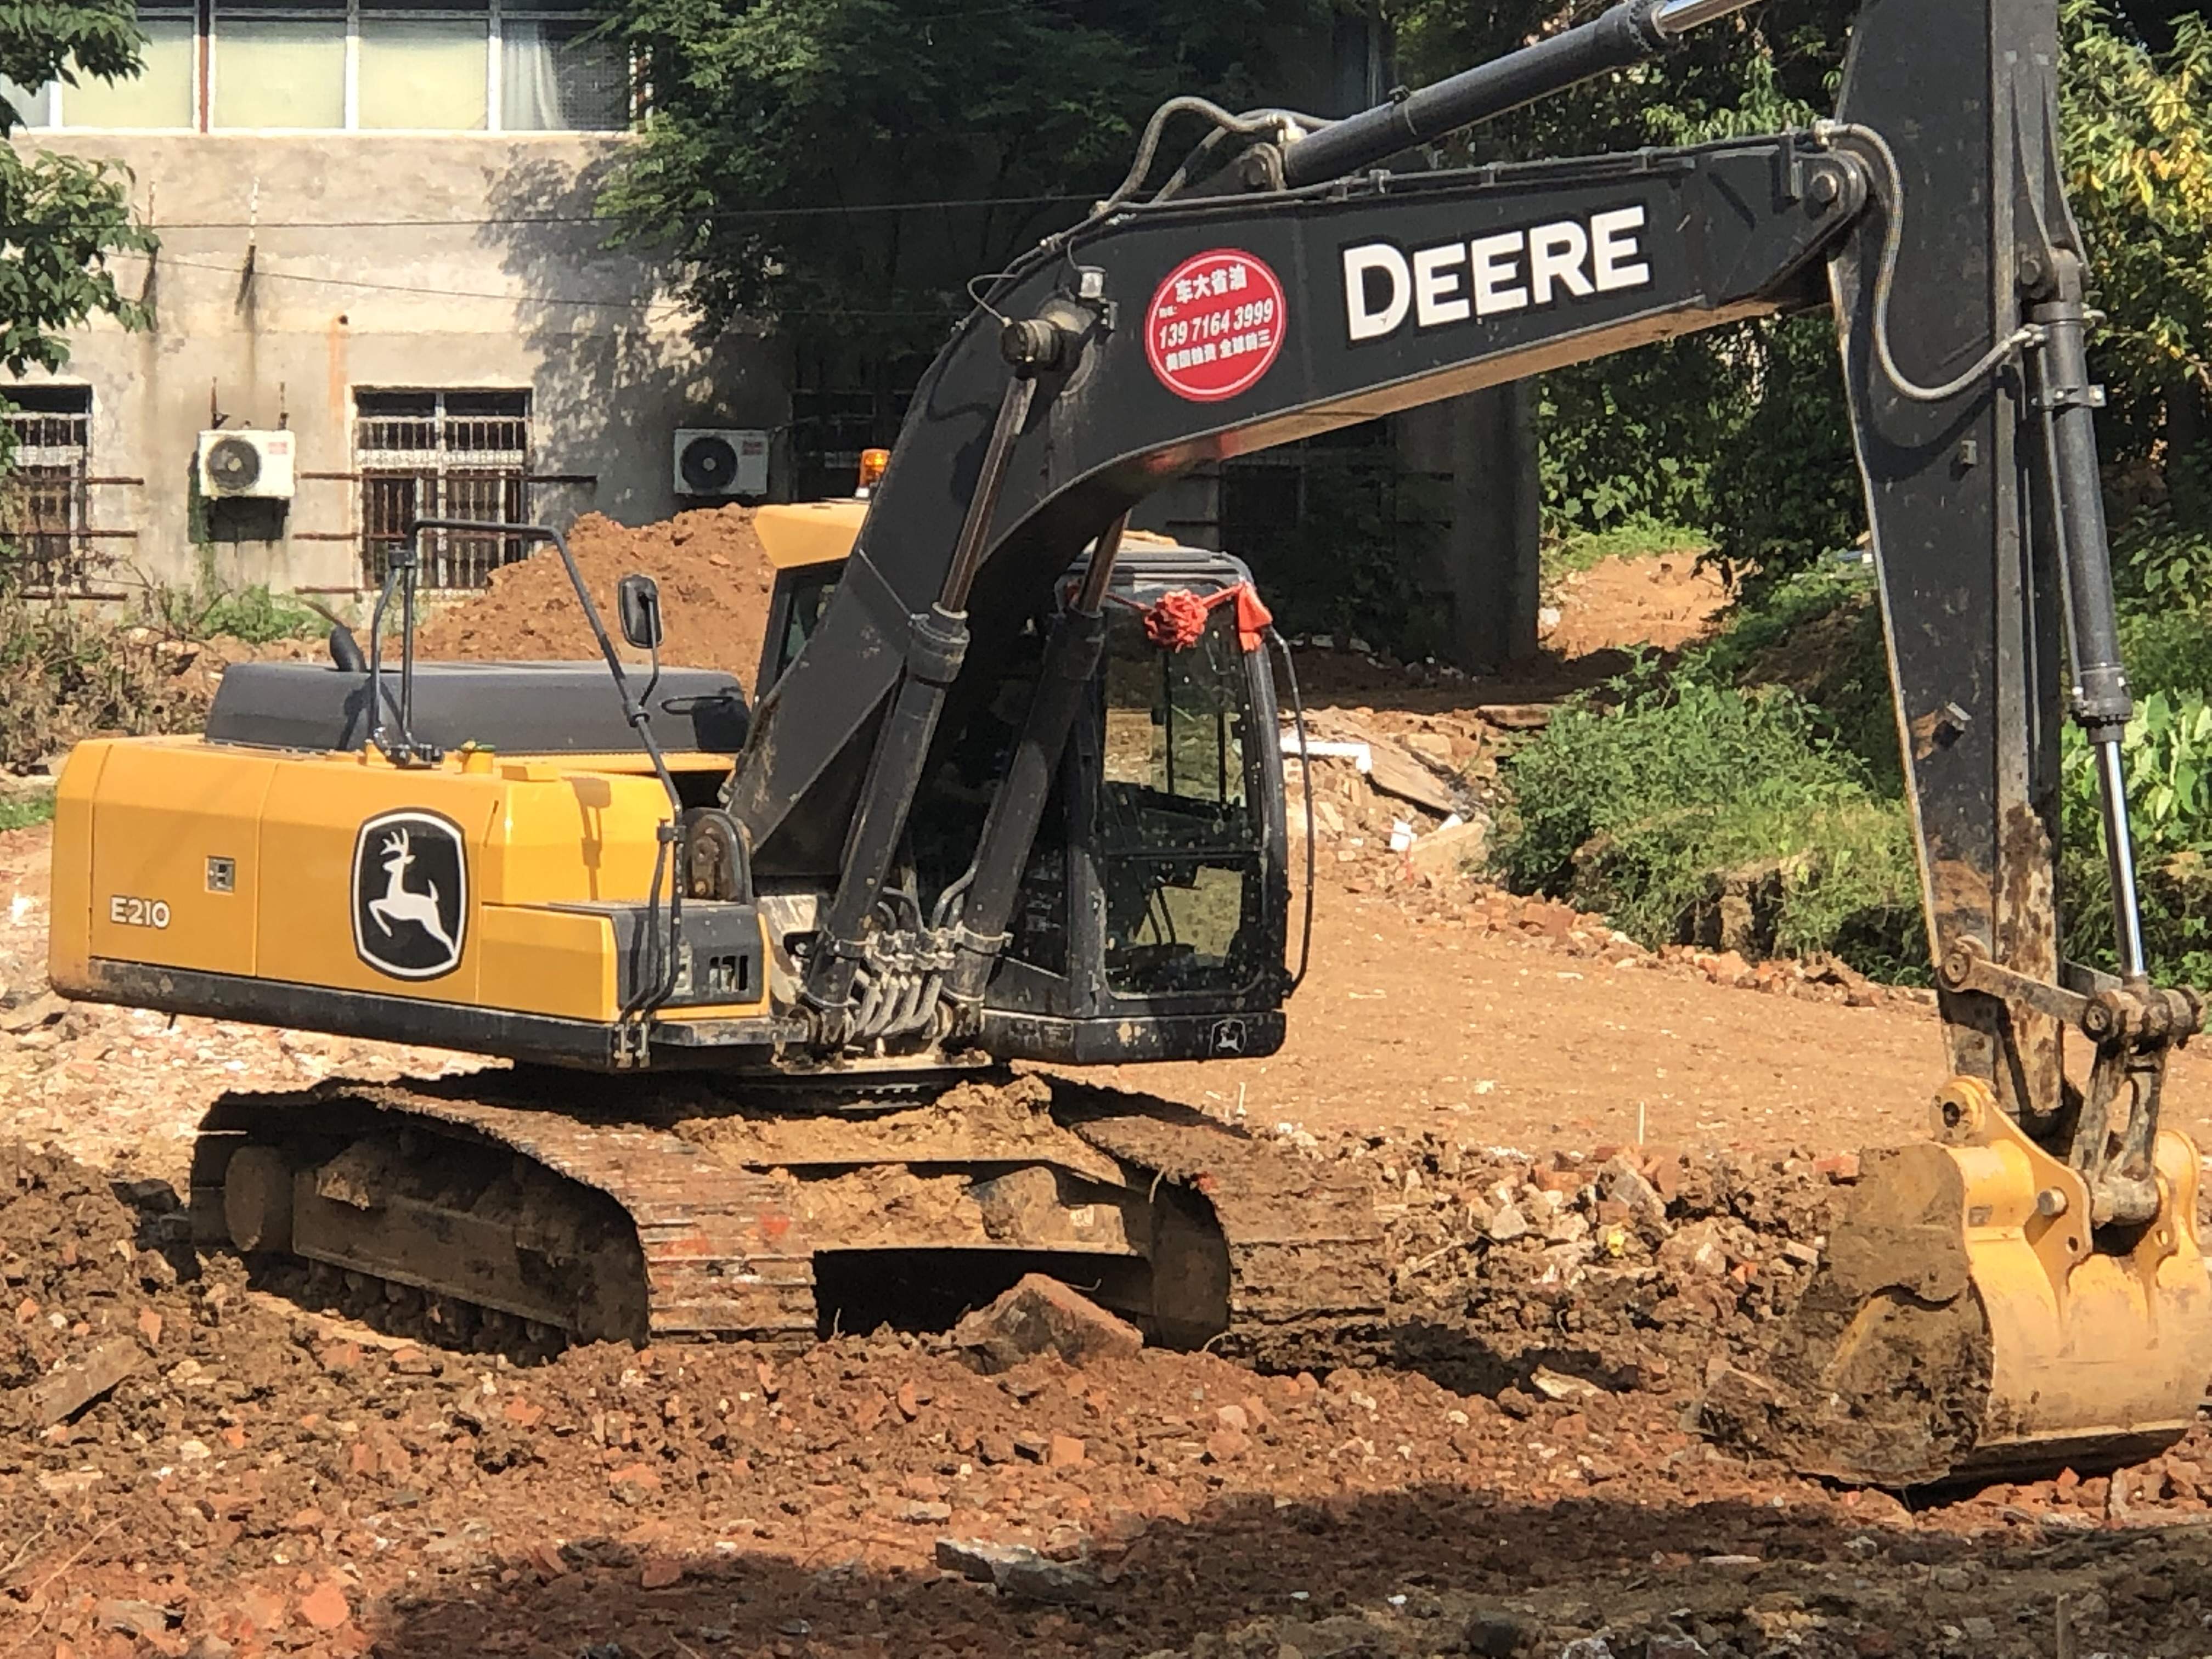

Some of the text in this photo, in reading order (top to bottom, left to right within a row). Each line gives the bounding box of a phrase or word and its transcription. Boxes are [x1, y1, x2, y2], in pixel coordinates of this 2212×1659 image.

[1344, 205, 1650, 341] DEERE
[1159, 320, 1188, 349] 139
[1190, 309, 1231, 341] 7164
[1233, 297, 1274, 331] 3999
[111, 895, 171, 929] E210
